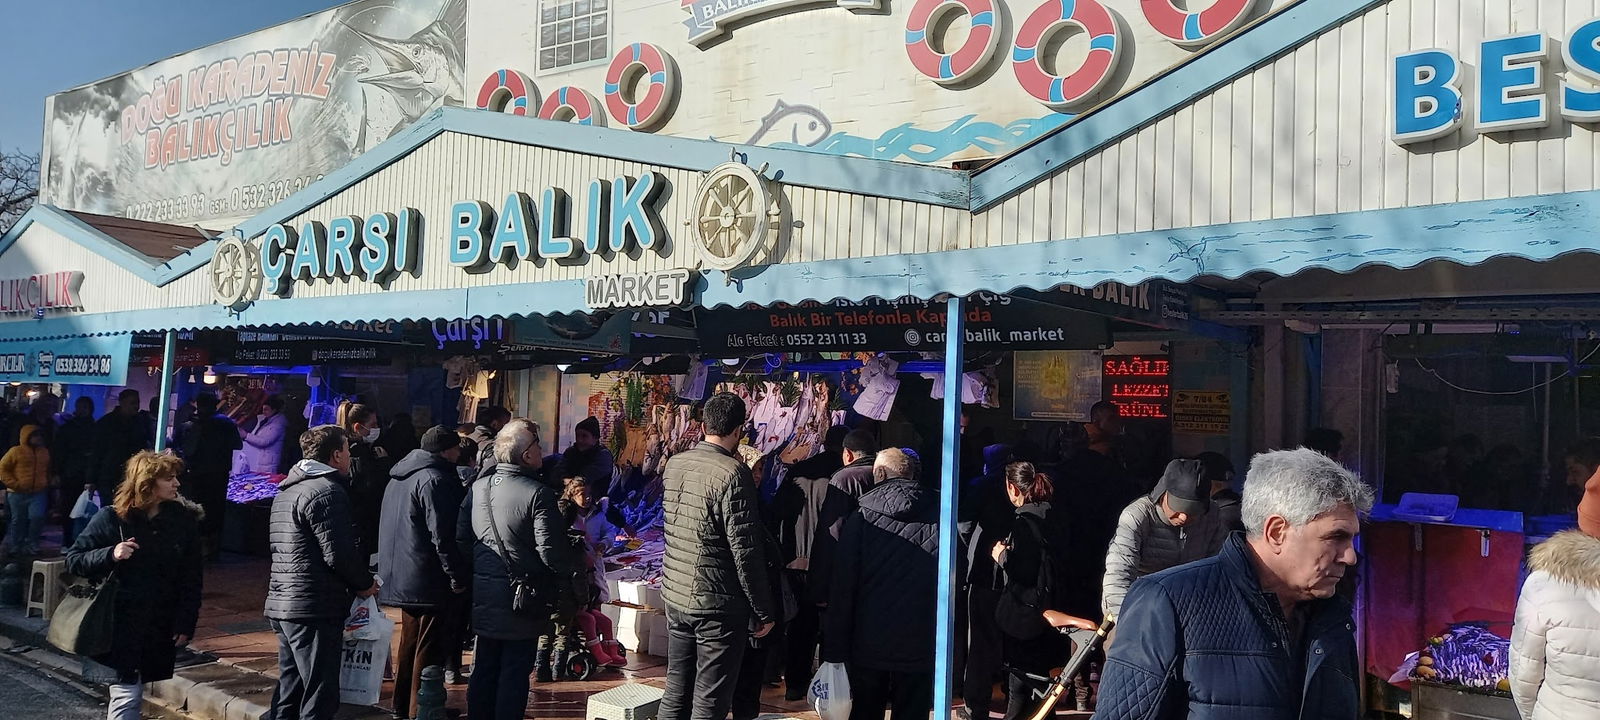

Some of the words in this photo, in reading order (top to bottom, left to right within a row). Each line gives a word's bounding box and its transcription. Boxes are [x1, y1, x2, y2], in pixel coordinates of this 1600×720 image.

[119, 74, 183, 146] DOĞU
[186, 39, 337, 111] KARADENİZ
[144, 95, 294, 171] BALIKÇILIK
[242, 183, 266, 211] 532
[260, 206, 413, 294] ÇARŞI
[449, 170, 657, 268] BALIK
[587, 272, 687, 305] MARKET
[769, 312, 808, 328] Balık
[810, 310, 832, 327] Bir
[834, 308, 912, 326] Telefonla
[727, 333, 745, 347] Alo
[787, 334, 815, 346] 0552
[817, 334, 837, 346] 231
[837, 333, 850, 345] 11
[853, 333, 867, 345] 33
